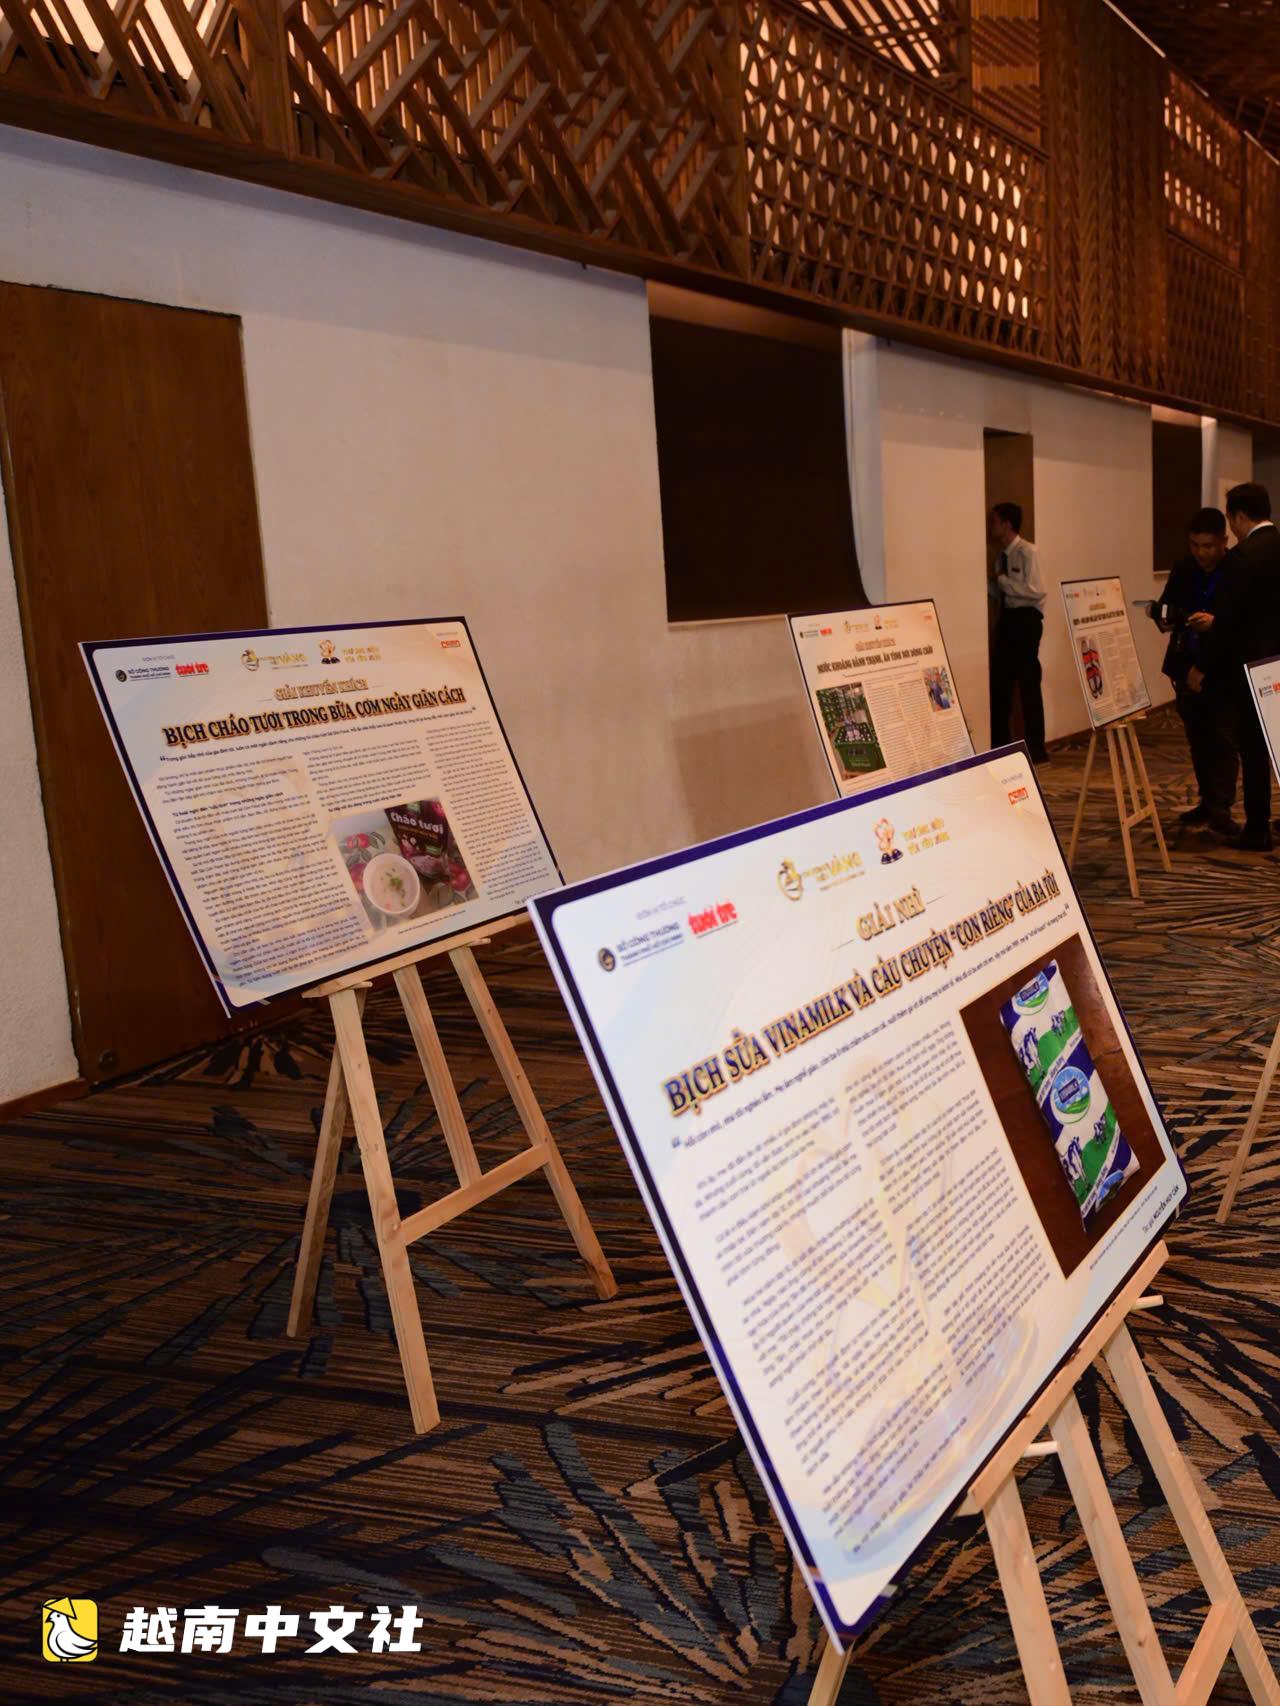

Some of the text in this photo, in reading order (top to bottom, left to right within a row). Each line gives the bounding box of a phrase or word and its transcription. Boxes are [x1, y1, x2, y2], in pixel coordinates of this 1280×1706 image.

[163, 723, 207, 749] BỊCH
[207, 714, 249, 742] CHÁO
[249, 710, 284, 733] TƯƠI
[284, 706, 329, 729] TRONG
[329, 699, 357, 721] BỮA
[356, 699, 382, 717] CƠM
[381, 692, 412, 713] NGÀY
[411, 688, 438, 710] GIÃN
[436, 685, 467, 705] CÁCH
[857, 884, 926, 941] GIẢI NHÌ
[662, 1055, 728, 1116] BỊCH
[723, 1027, 770, 1084] SỮA
[761, 983, 854, 1057] VINAMILK
[848, 968, 876, 1010] VÀ
[871, 954, 902, 998] CÂU
[900, 927, 954, 980] CHUYỆN
[1013, 880, 1037, 916] CỦA
[1031, 879, 1047, 907] BA
[1044, 868, 1061, 901] TÔI
